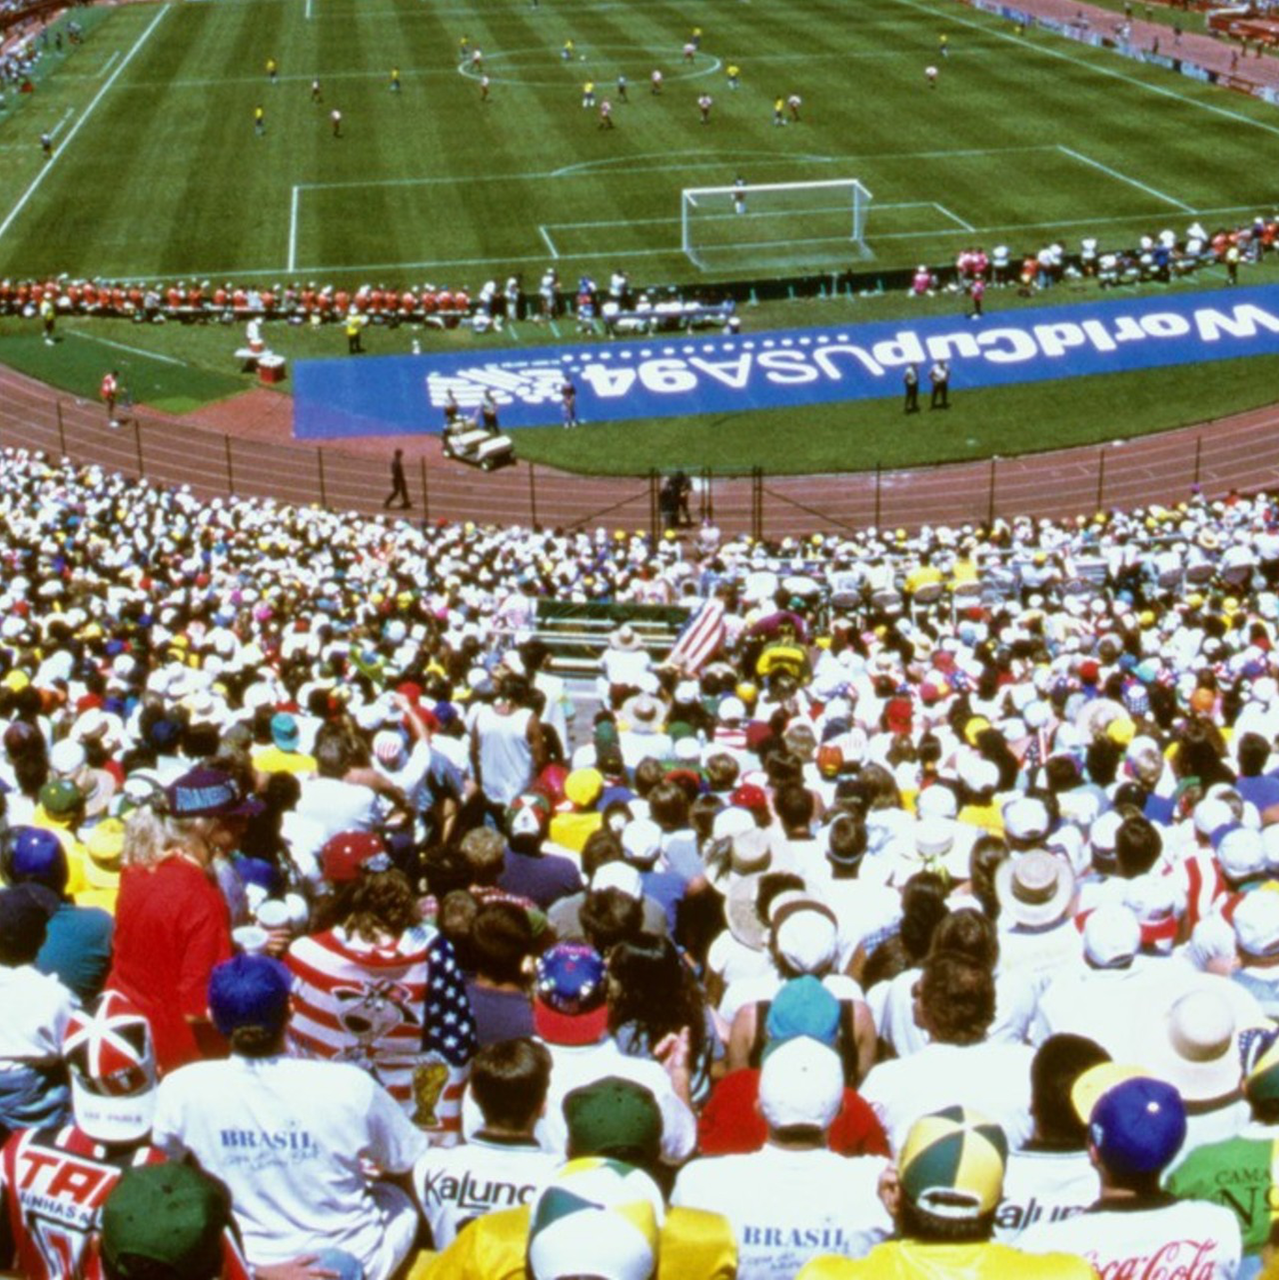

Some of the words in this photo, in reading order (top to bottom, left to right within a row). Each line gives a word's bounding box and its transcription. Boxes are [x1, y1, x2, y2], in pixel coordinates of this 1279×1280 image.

[220, 1128, 314, 1151] BRASIL
[20, 1150, 122, 1208] TA
[743, 1225, 845, 1248] BRASIL
